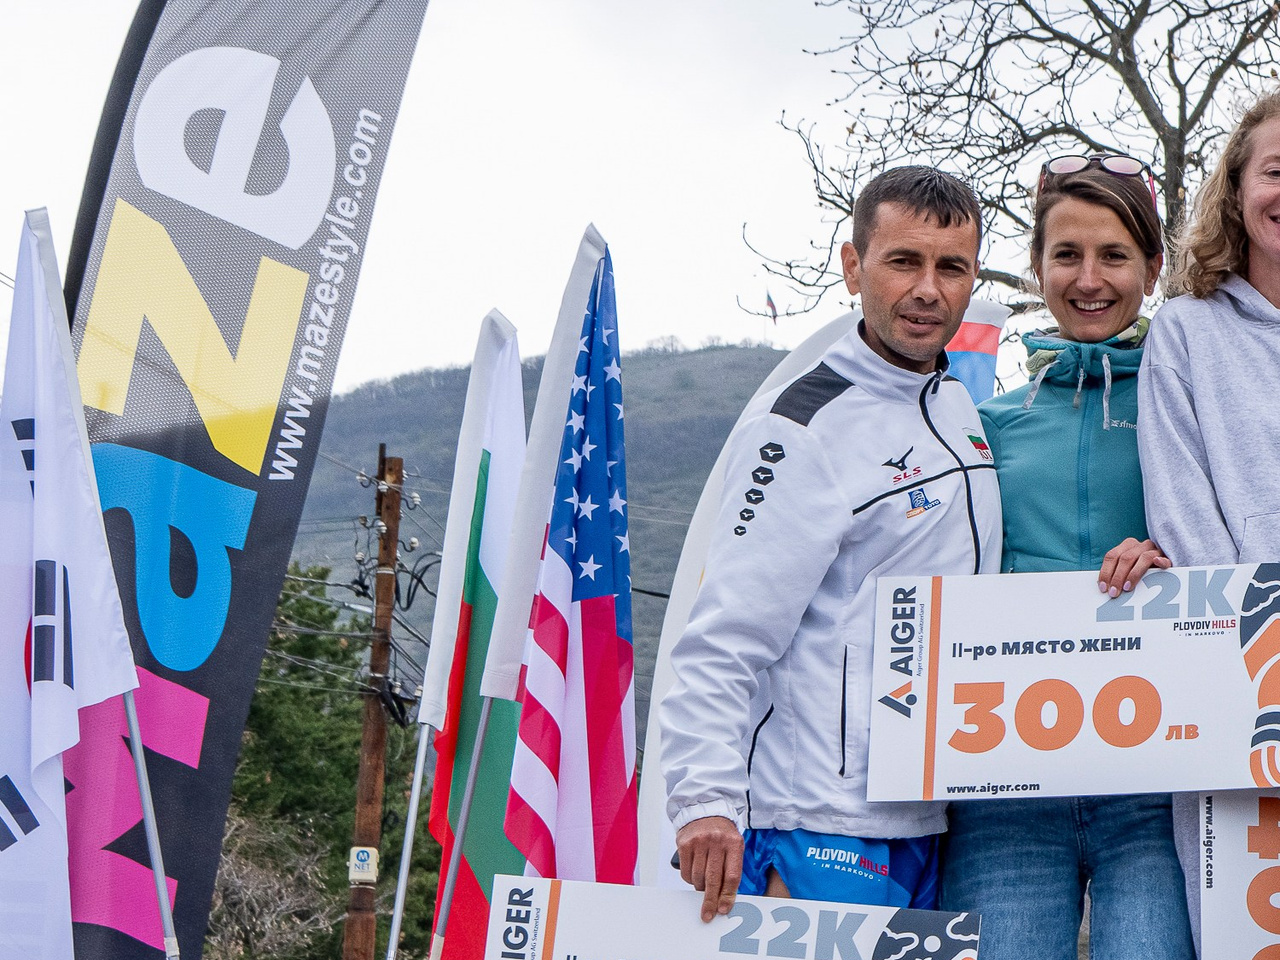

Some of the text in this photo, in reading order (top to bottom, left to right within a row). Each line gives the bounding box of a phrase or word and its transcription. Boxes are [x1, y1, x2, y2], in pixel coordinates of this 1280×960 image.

[268, 108, 383, 482] www.mazestyle.com
[893, 466, 921, 483] SLS
[890, 586, 917, 676] AIGER
[1173, 619, 1236, 631] PLOVDIV HILLS
[1001, 638, 1076, 656] МЯСТО
[1080, 636, 1142, 653] ЖЕНИ
[948, 675, 1199, 753] 300 лв
[946, 781, 1040, 796] www.aiger.com
[1203, 795, 1216, 889] www.aiger.com
[354, 863, 370, 871] NET
[807, 847, 888, 876] PLOVDIV HILLS
[834, 865, 874, 880] MARKOVO
[532, 907, 541, 942] Switzerland
[531, 942, 537, 952] AG
